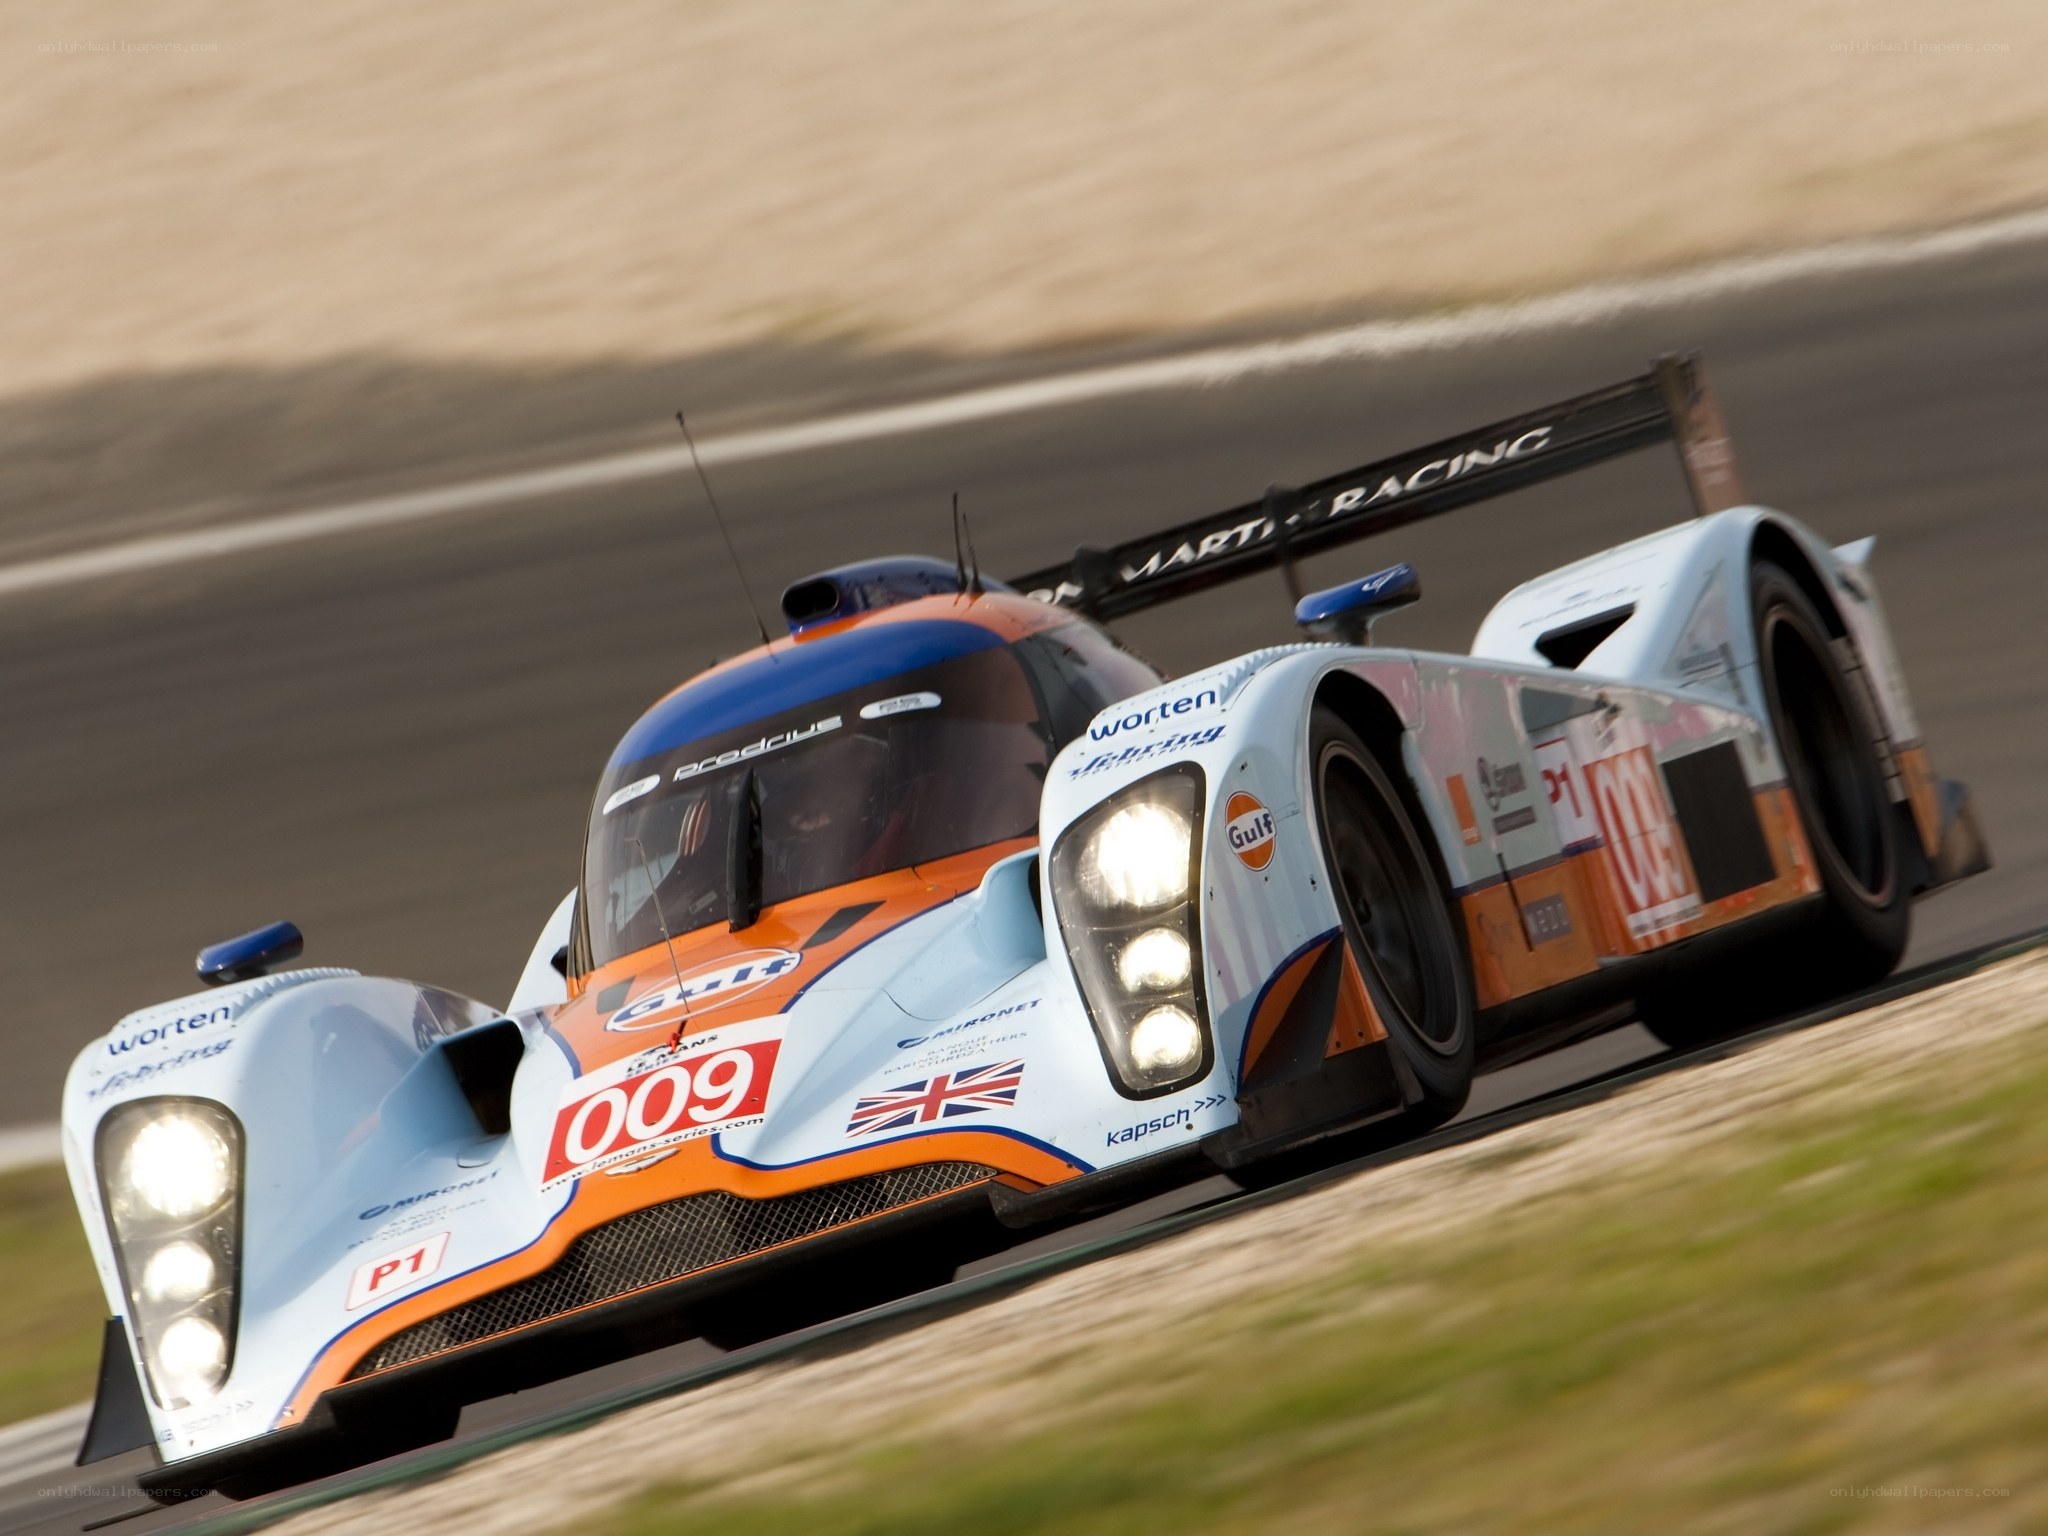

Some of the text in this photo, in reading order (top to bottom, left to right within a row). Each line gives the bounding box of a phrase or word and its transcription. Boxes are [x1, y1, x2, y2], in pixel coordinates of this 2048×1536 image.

[1121, 426, 1553, 584] MARTI RACING
[1090, 690, 1216, 741] worten
[673, 715, 842, 782] prodrive
[1542, 762, 1583, 819] P1
[1228, 813, 1274, 849] Gulf
[613, 955, 797, 1023] Gulf
[108, 1006, 229, 1055] worten
[932, 998, 1042, 1040] MIRONET
[565, 1049, 754, 1164] 009
[1107, 1109, 1190, 1147] kapsch
[541, 1117, 764, 1194] www.lemans-series.com
[368, 1248, 426, 1292] P1
